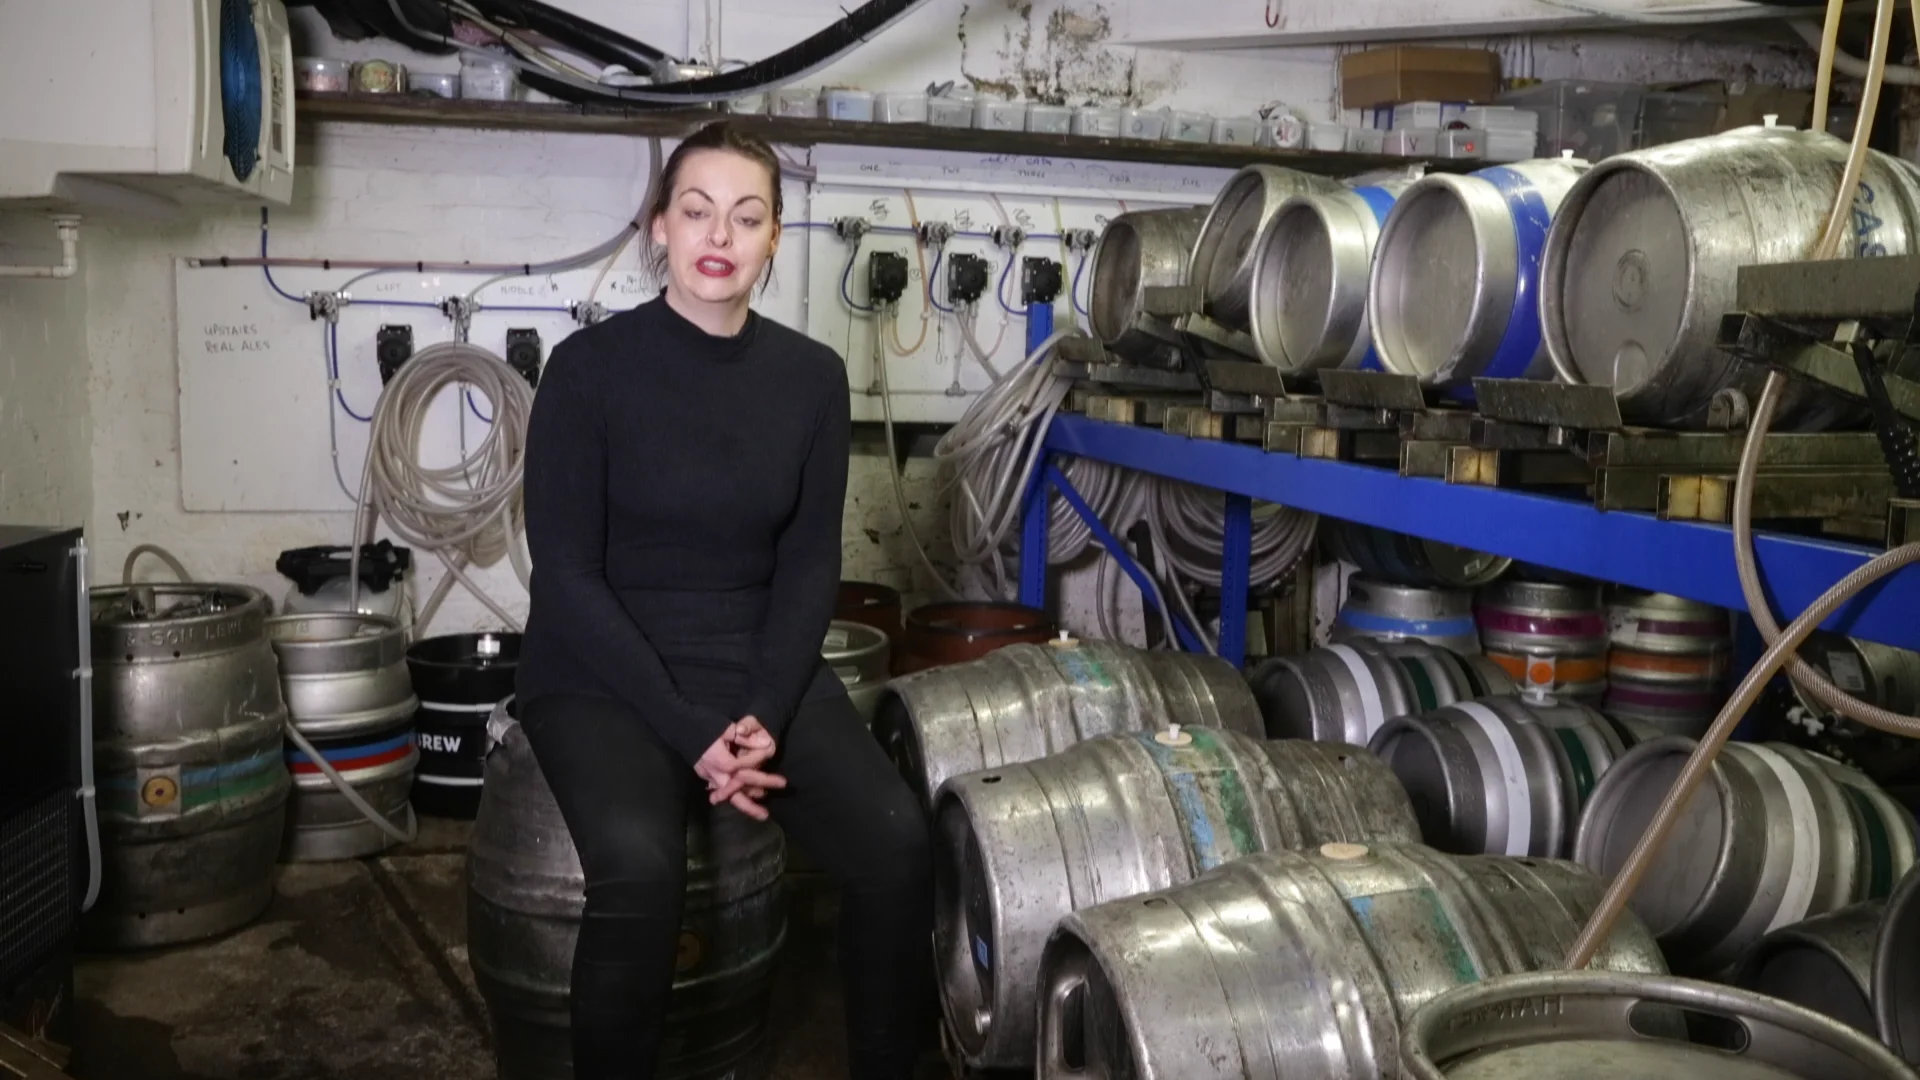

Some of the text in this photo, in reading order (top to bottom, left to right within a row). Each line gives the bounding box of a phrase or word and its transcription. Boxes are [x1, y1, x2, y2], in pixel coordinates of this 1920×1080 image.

[1180, 122, 1191, 137] P
[1226, 128, 1235, 142] R
[1409, 137, 1419, 152] V
[859, 163, 882, 173] ONE
[203, 322, 258, 337] UPSTAIRS
[204, 339, 271, 354] REAL ALES
[150, 627, 194, 646] SON
[418, 732, 462, 753] REW
